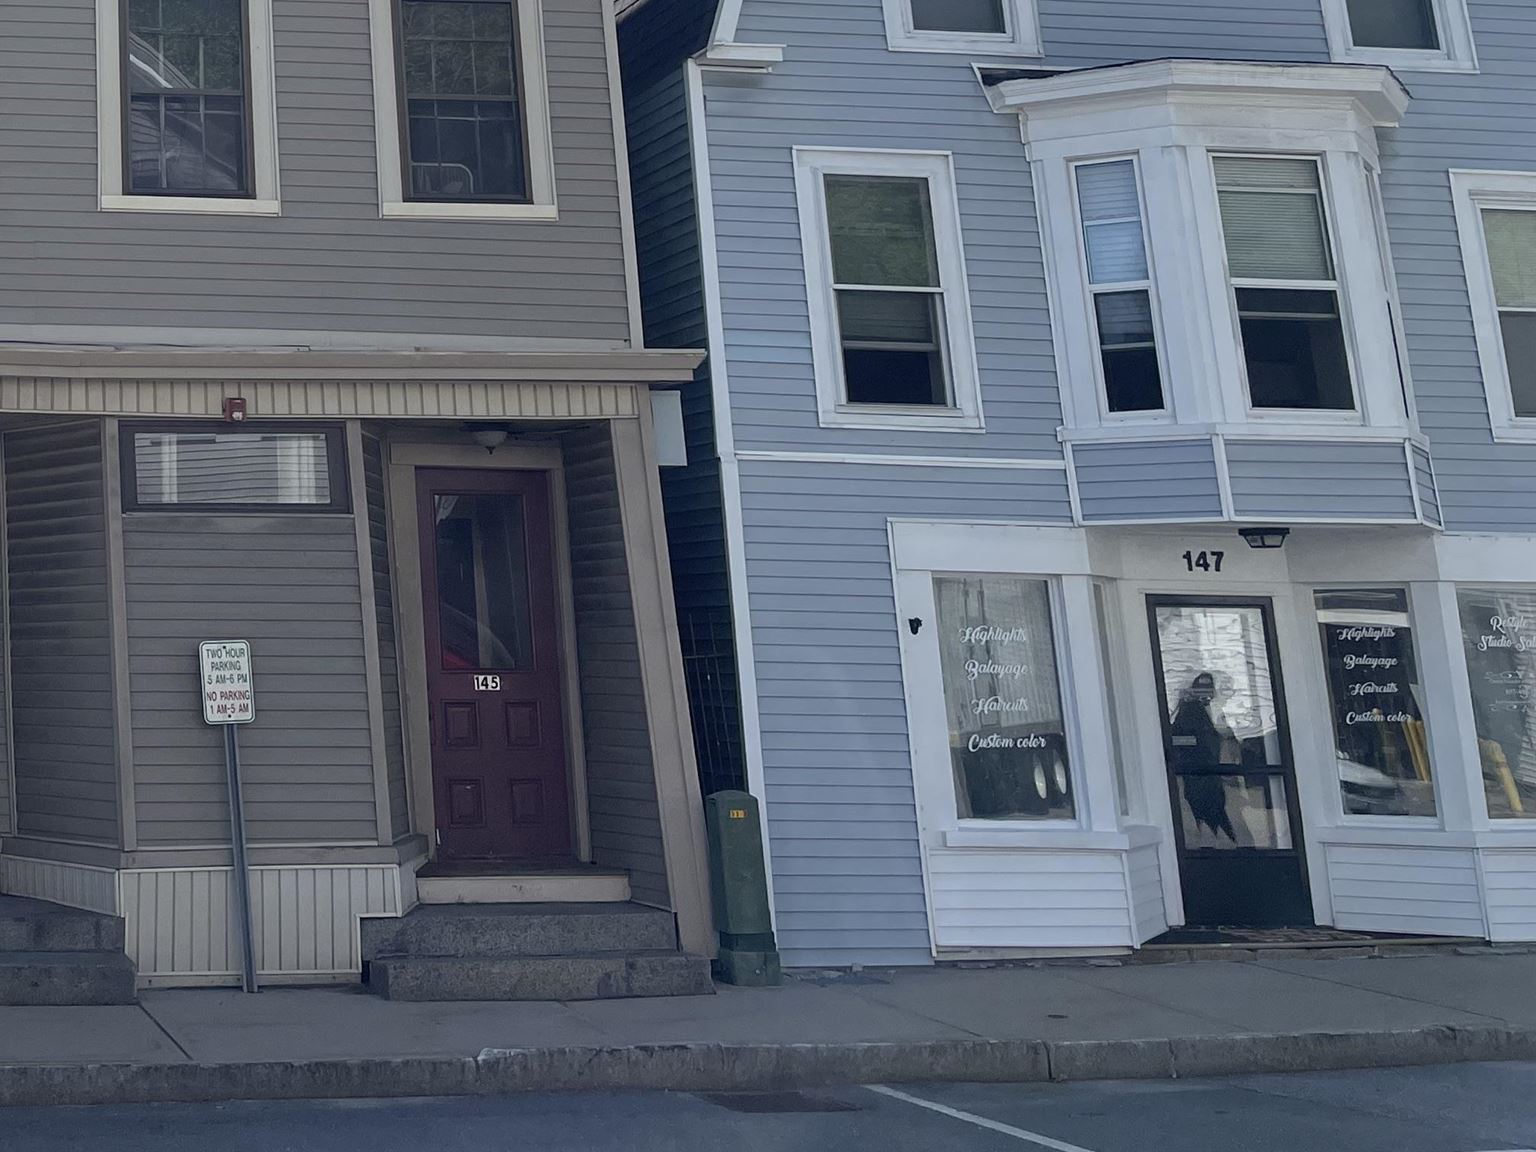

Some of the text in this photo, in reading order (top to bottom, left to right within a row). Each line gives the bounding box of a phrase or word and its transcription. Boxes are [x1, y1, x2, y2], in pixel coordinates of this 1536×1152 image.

[1183, 550, 1224, 572] 147
[959, 625, 1026, 645] Highlights
[1337, 626, 1396, 641] Highlights
[1477, 635, 1512, 651] Studio
[206, 648, 245, 659] TWO HOUR
[211, 660, 241, 672] PARKING
[1344, 654, 1398, 670] Balayage
[965, 659, 1028, 681] Balayage
[237, 674, 248, 684] PM
[475, 676, 499, 690] 145
[207, 690, 250, 702] NO PARKING
[1349, 682, 1399, 696] Haircuts
[238, 703, 249, 713] AM
[971, 696, 1028, 714] Haircuts
[1346, 711, 1412, 725] Custom color
[968, 733, 1046, 752] Custom color
